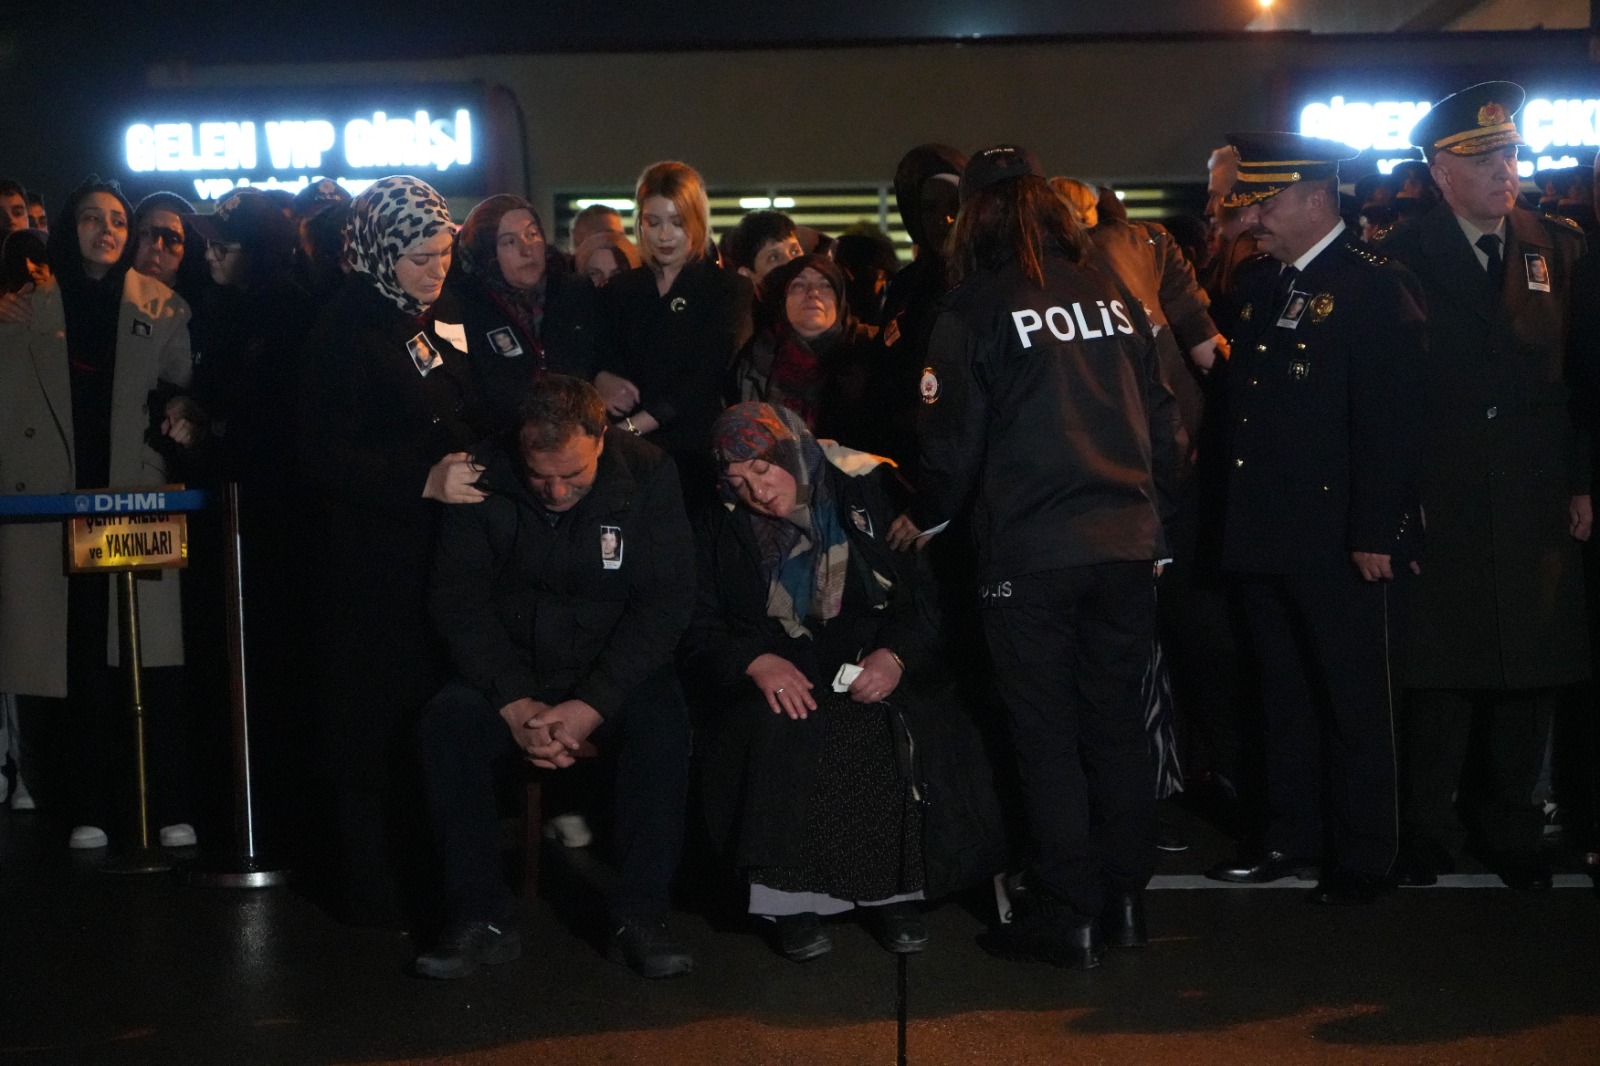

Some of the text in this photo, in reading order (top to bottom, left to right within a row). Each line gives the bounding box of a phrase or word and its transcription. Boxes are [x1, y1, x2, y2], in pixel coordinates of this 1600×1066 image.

[126, 123, 257, 171] GELEN
[265, 119, 336, 170] VIP
[88, 531, 172, 559] ve YAKINLARI
